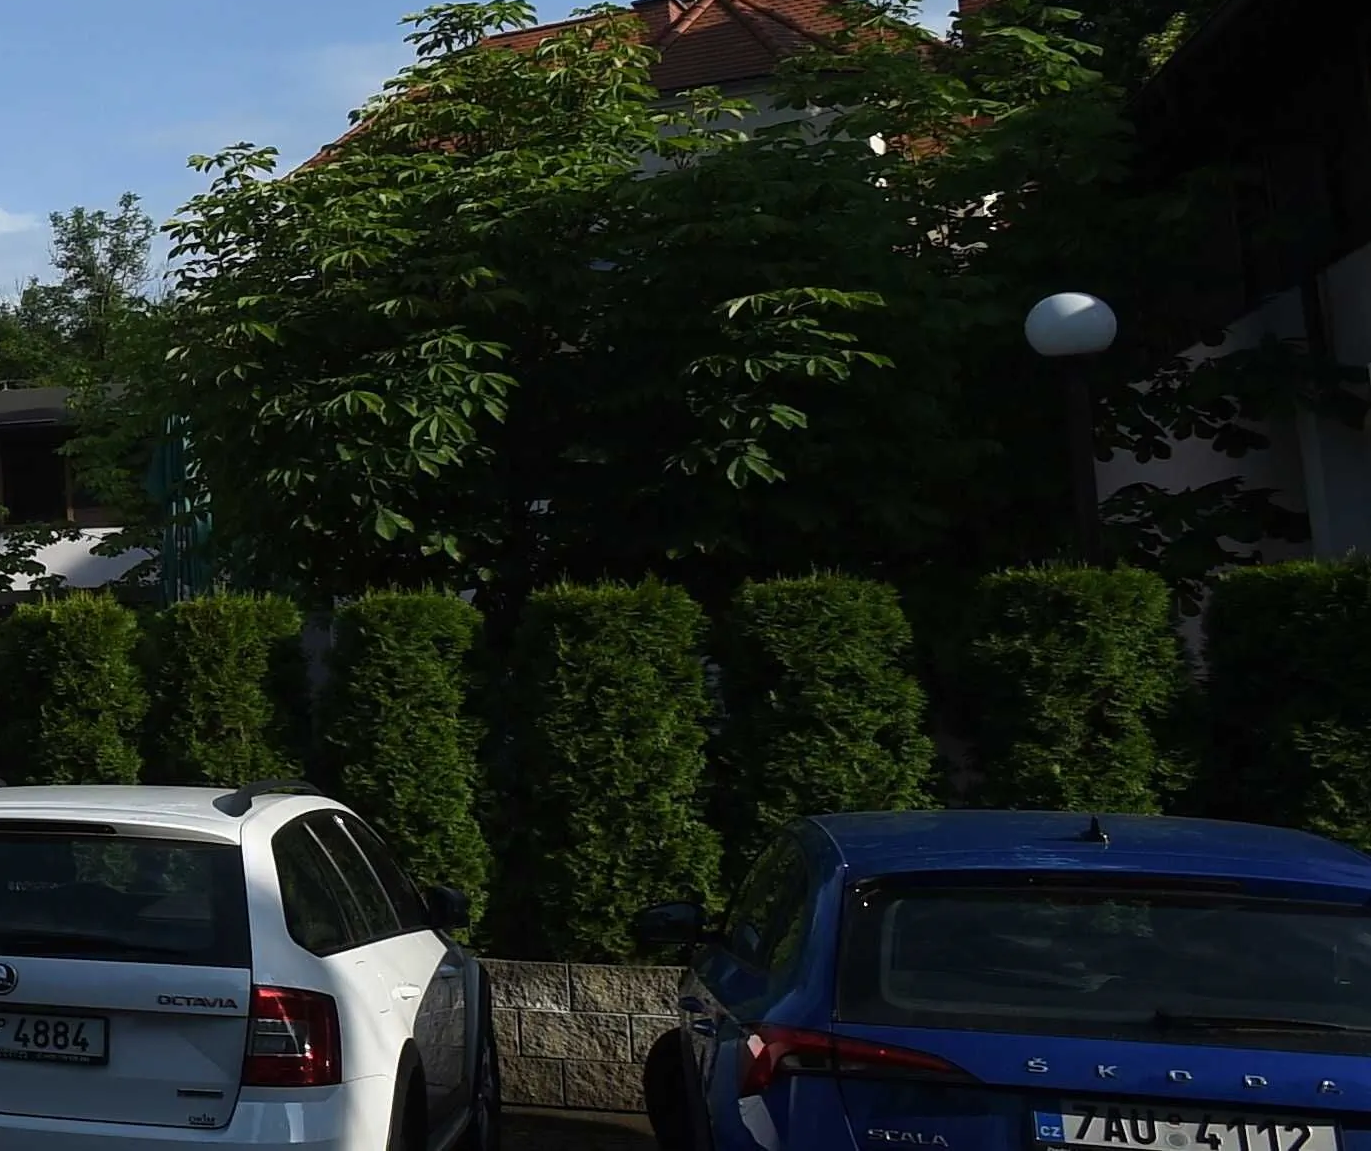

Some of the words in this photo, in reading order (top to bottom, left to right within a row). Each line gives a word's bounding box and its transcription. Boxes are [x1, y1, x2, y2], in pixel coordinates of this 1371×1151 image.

[157, 994, 238, 1010] OCTAVIA
[13, 1017, 90, 1052] 4884
[1027, 1057, 1343, 1095] ŠKODA
[867, 1128, 949, 1148] SCALA
[1040, 1125, 1061, 1138] CZ
[1071, 1105, 1157, 1146] 7AU
[1195, 1112, 1314, 1151] 4112
